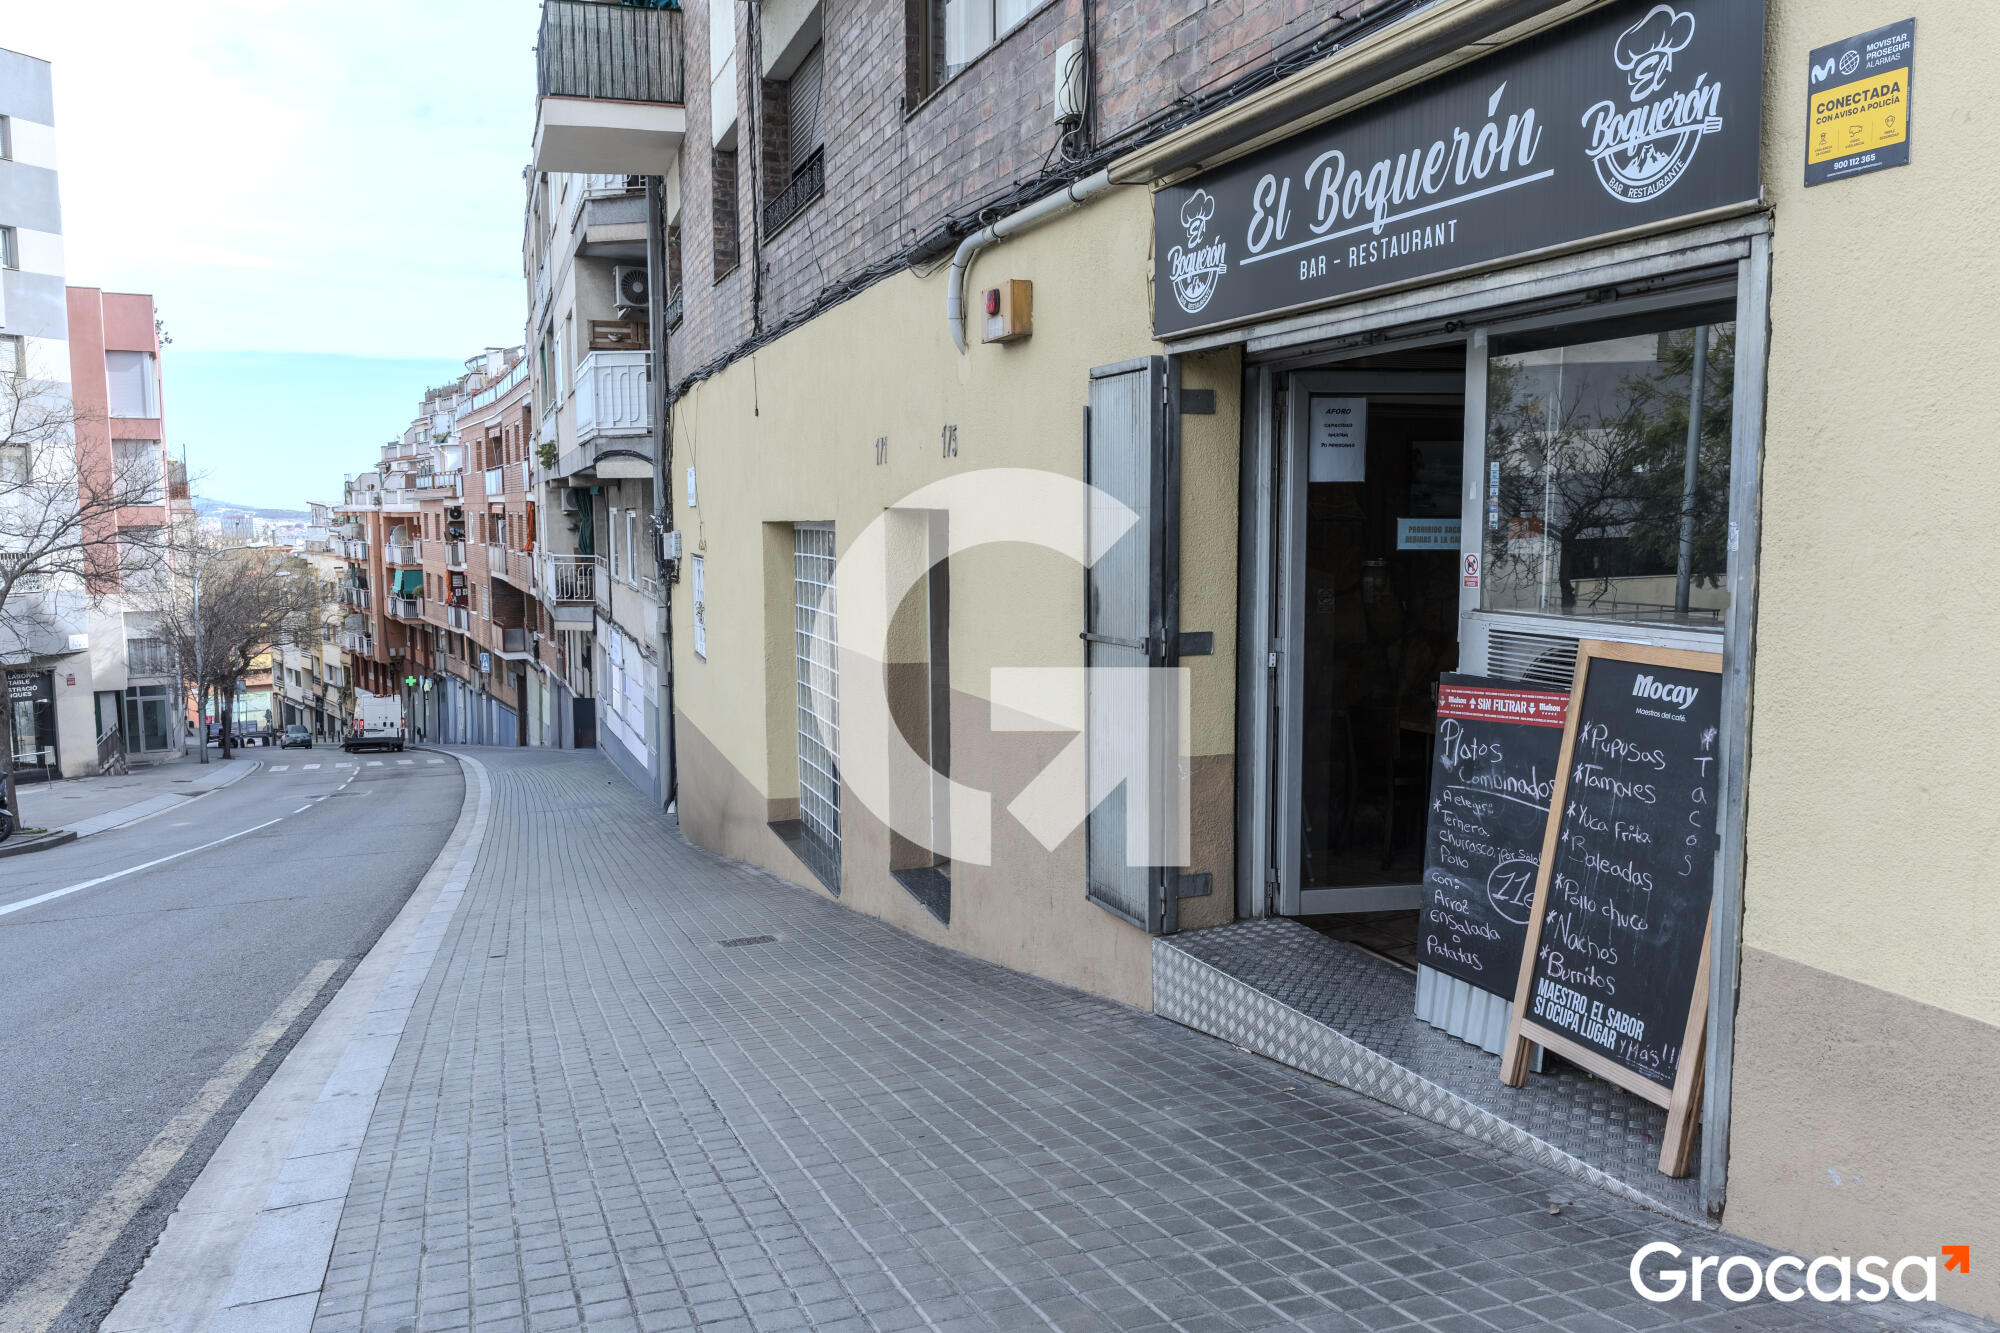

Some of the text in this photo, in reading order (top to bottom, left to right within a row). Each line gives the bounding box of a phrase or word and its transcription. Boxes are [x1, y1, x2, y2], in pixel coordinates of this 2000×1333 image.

[1866, 33, 1907, 52] MOVISTAR
[1866, 41, 1910, 60] PROSEGUR
[1865, 52, 1901, 69] ALARMAS
[1630, 54, 1668, 102] El
[1582, 72, 1721, 156] Boquerón
[1815, 94, 1900, 125] CON AVISO A POLICÍA
[1816, 82, 1900, 114] CONECTADA
[1247, 80, 1543, 253] El Boquerón
[1833, 159, 1848, 170] 900
[1849, 157, 1860, 166] 112
[1860, 153, 1876, 163] 365
[1608, 158, 1684, 198] BAR RESTAURANTE
[1188, 219, 1204, 249] El
[1300, 257, 1327, 281] BAR
[1348, 219, 1457, 269] RESTAURANT
[1168, 235, 1226, 283] Boquerón
[1325, 407, 1352, 415] AFORO
[942, 424, 958, 459] 175
[1477, 698, 1492, 711] SIN
[1493, 699, 1527, 714] FILTRAR
[1632, 673, 1699, 710] Mocay
[1635, 707, 1661, 718] Maestros
[1661, 711, 1671, 720] del
[1440, 718, 1503, 766] Platos
[1614, 822, 1651, 844] Frita
[1440, 845, 1469, 869] Pollo
[1434, 889, 1470, 914] Arroz
[1426, 935, 1483, 971] Patatas
[1538, 977, 1645, 1041] MAESTRO, EL SABOR
[1546, 1001, 1579, 1033] OCUPA
[1579, 1014, 1617, 1050] LUGAR
